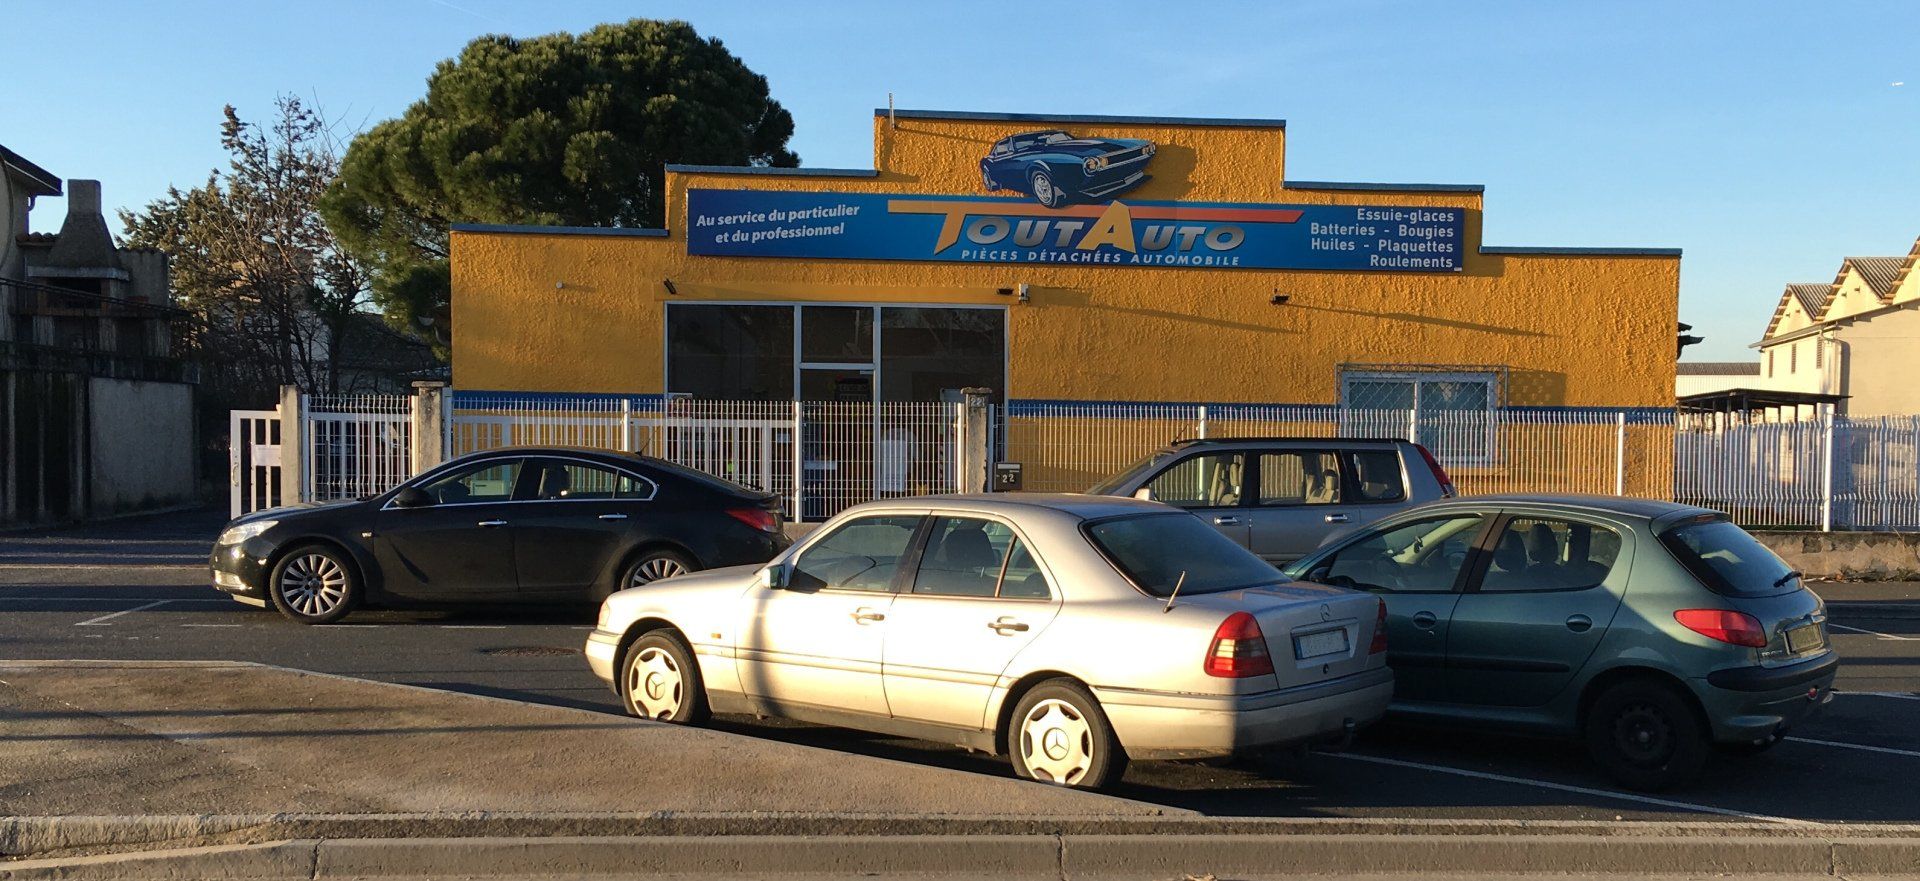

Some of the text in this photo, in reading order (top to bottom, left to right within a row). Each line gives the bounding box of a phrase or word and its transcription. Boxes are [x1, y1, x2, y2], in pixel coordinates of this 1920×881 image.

[696, 204, 860, 227] Au service du particulier
[1357, 208, 1454, 224] Essuie-glaces
[715, 222, 845, 243] et du professionnel
[1310, 223, 1375, 236] Batteries
[1398, 224, 1454, 240] Bougies
[1311, 238, 1355, 251] Huiles
[1378, 239, 1453, 254] Plaquettes
[961, 247, 1240, 266] PIÈCES DÉTACHÉES AUTOMOBILE
[1370, 254, 1453, 268] Roulements
[1002, 474, 1015, 483] 22
